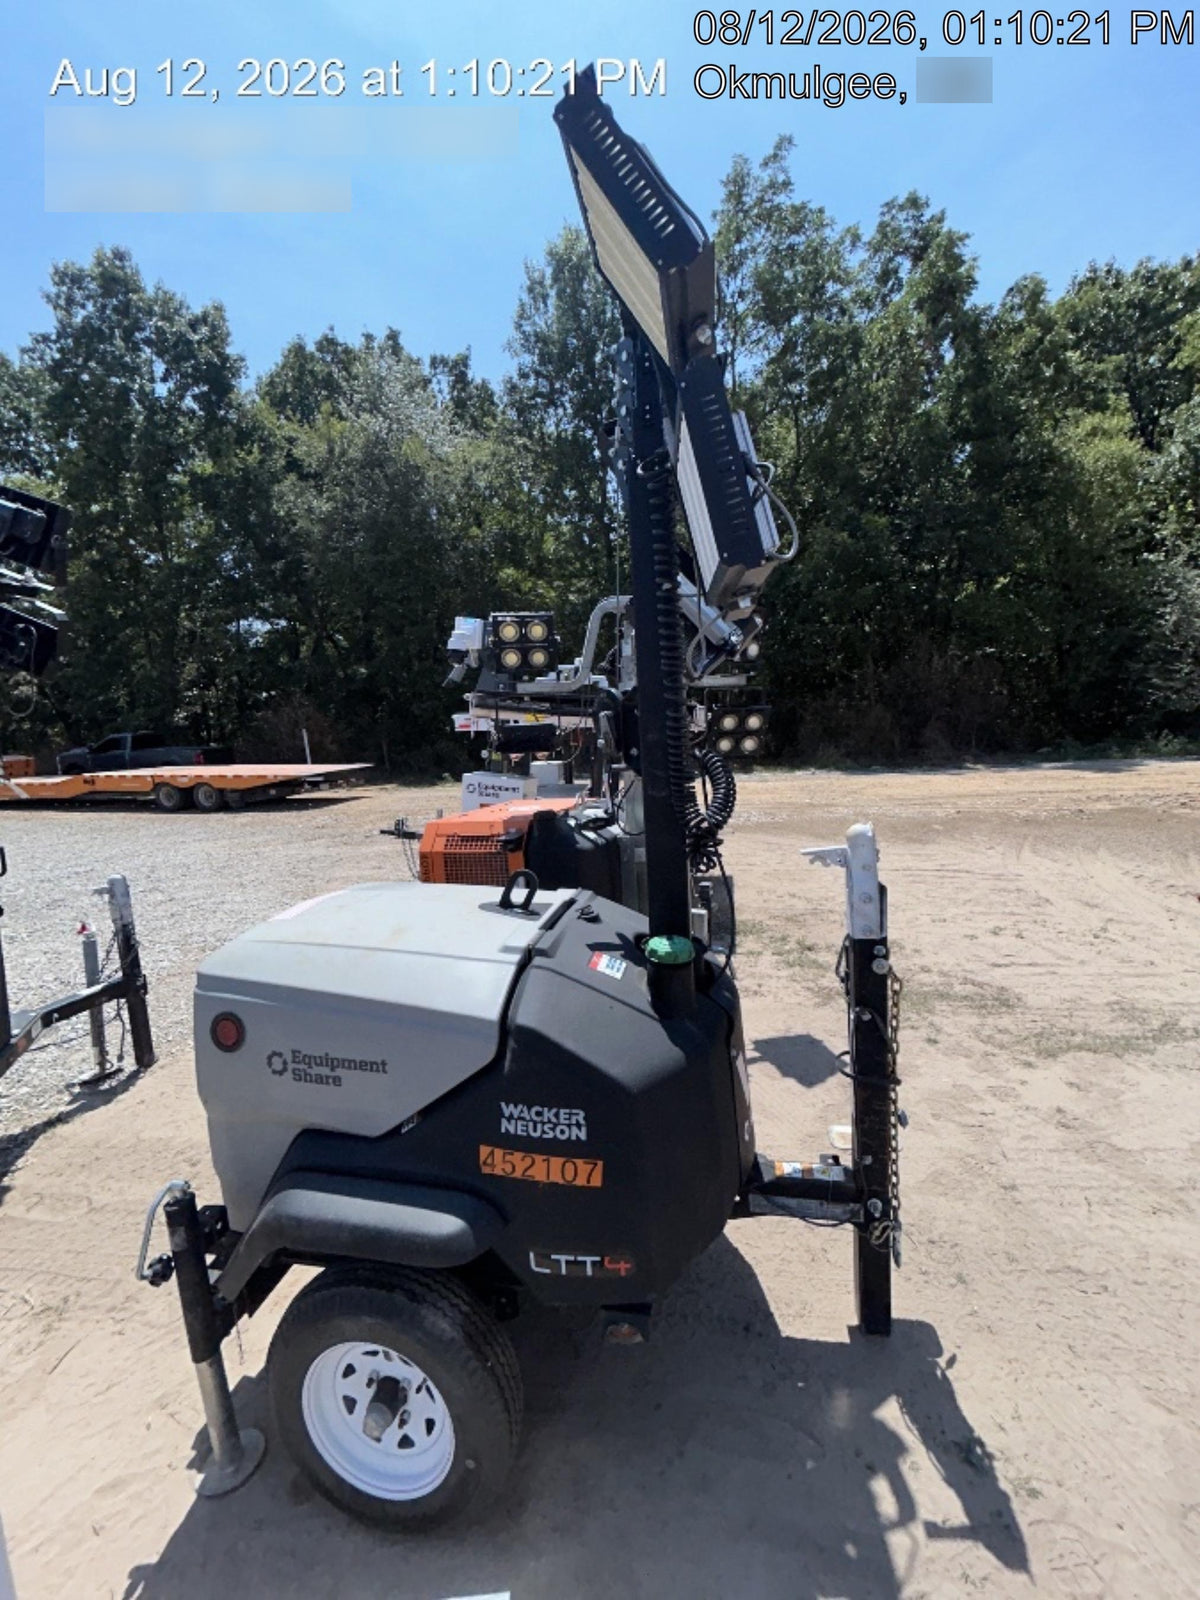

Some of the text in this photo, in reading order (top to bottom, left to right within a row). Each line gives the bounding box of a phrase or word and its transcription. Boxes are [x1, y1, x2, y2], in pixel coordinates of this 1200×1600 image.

[291, 1049, 388, 1074] Equipment
[292, 1067, 342, 1087] Share
[500, 1101, 586, 1125] WACKER
[500, 1118, 588, 1141] NEUSON
[482, 1148, 598, 1185] 452107
[529, 1251, 631, 1277] LTT4
